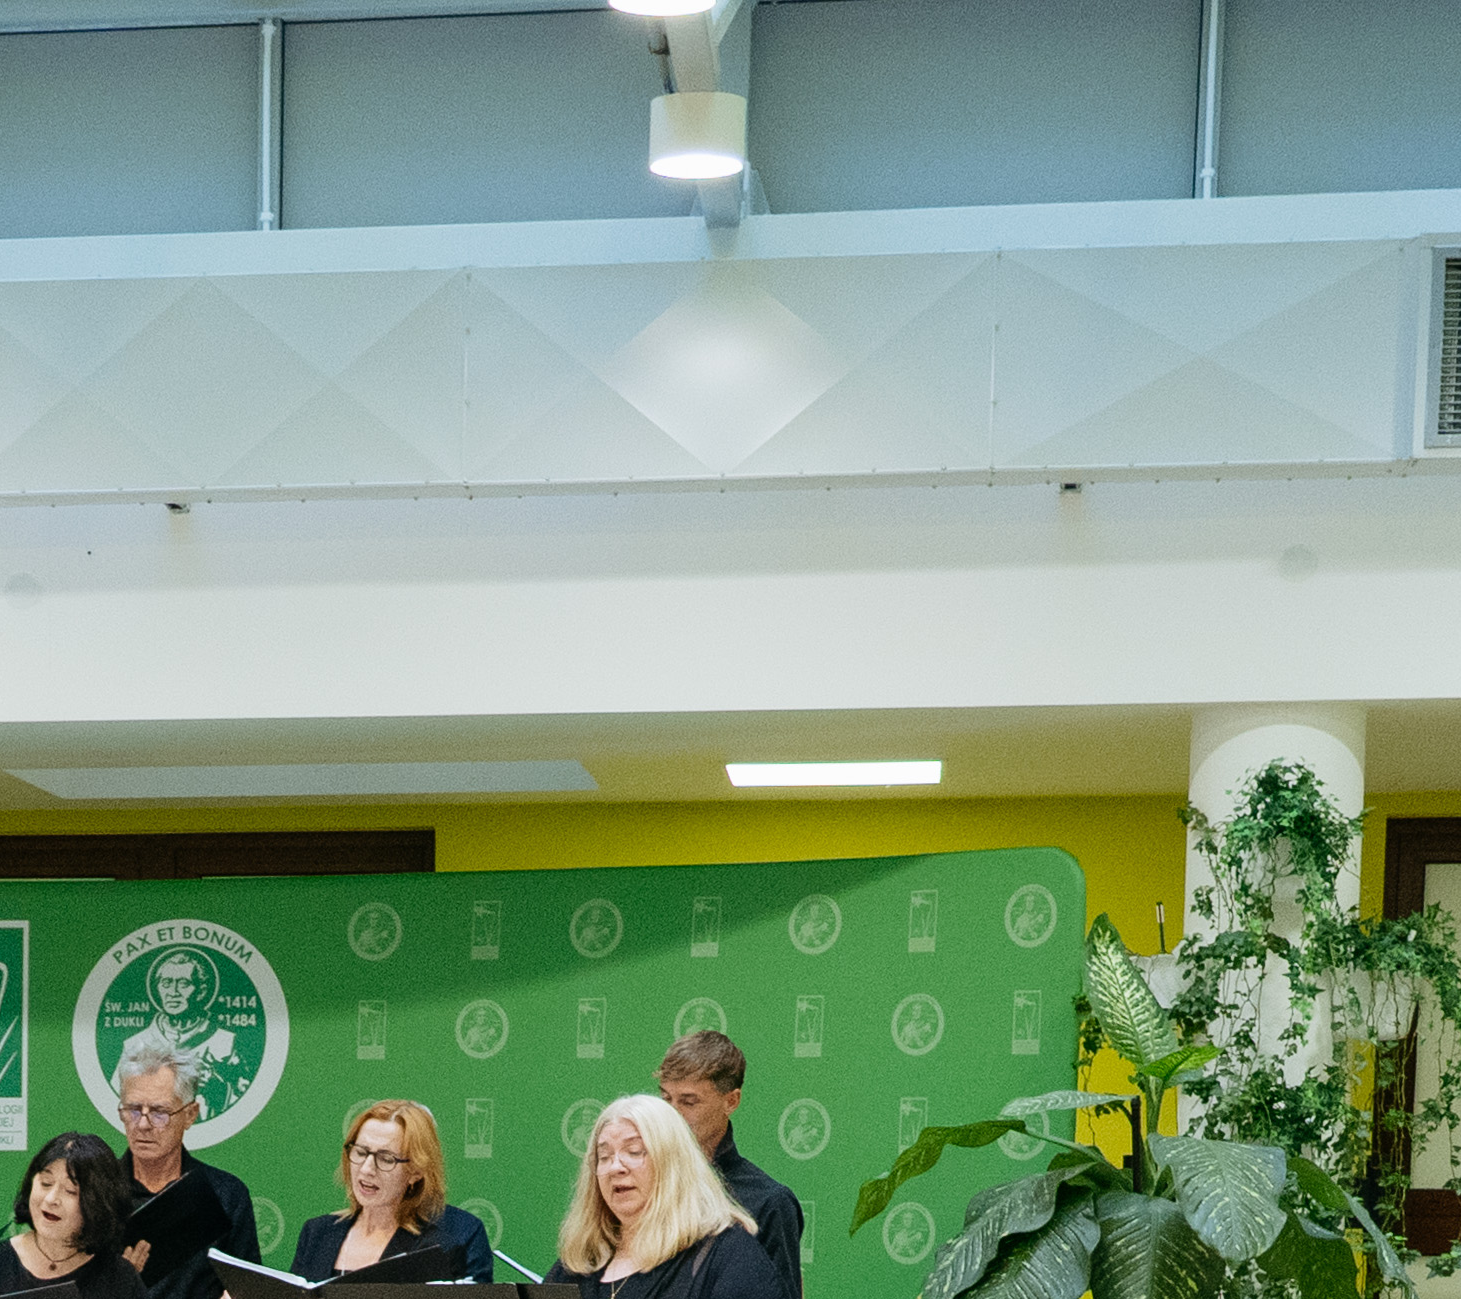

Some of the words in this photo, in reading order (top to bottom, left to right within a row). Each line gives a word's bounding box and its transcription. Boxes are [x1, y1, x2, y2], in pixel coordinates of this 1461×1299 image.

[112, 932, 152, 964] PAX
[156, 926, 176, 943] ET
[182, 925, 254, 964] BONUM
[127, 1001, 150, 1012] JAN
[113, 1016, 145, 1027] DUKLI
